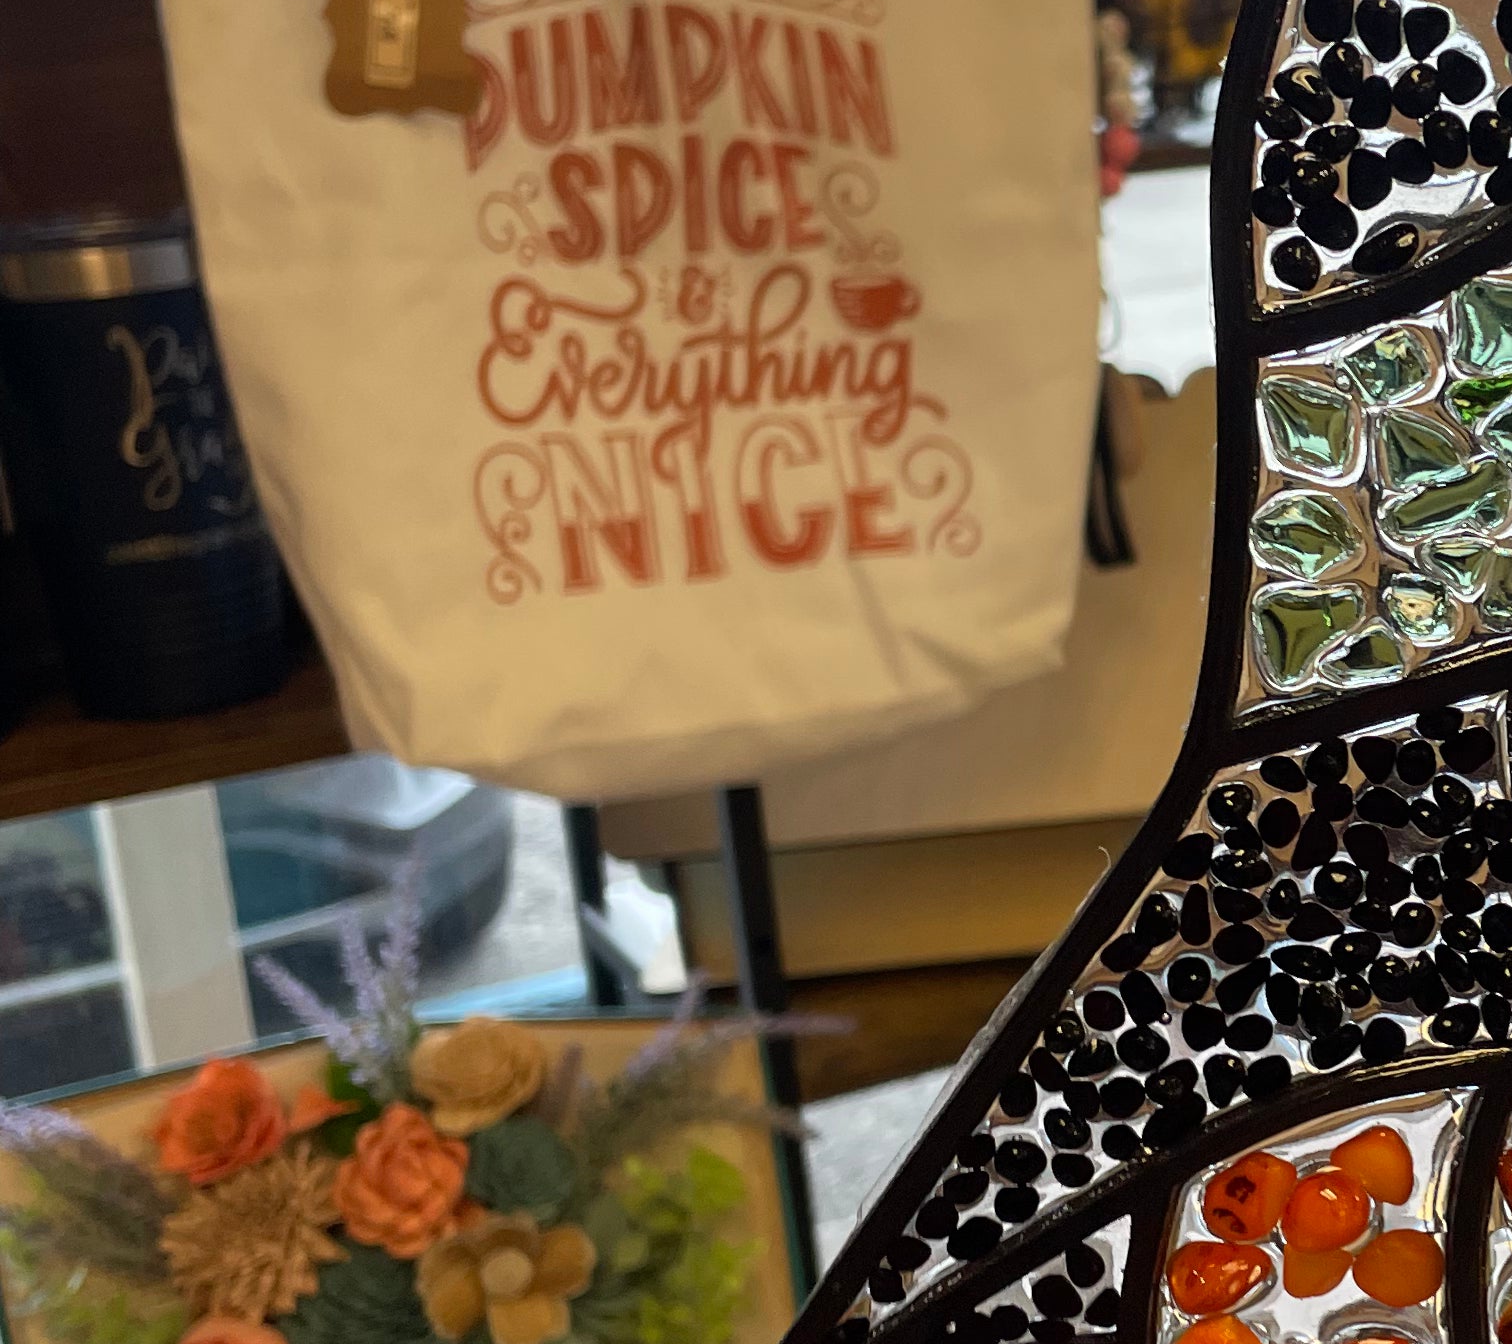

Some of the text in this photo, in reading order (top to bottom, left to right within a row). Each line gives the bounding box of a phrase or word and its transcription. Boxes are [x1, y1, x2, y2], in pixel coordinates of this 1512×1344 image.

[547, 133, 825, 264] SPICE
[477, 262, 948, 480] Everything
[538, 411, 915, 595] NICE
